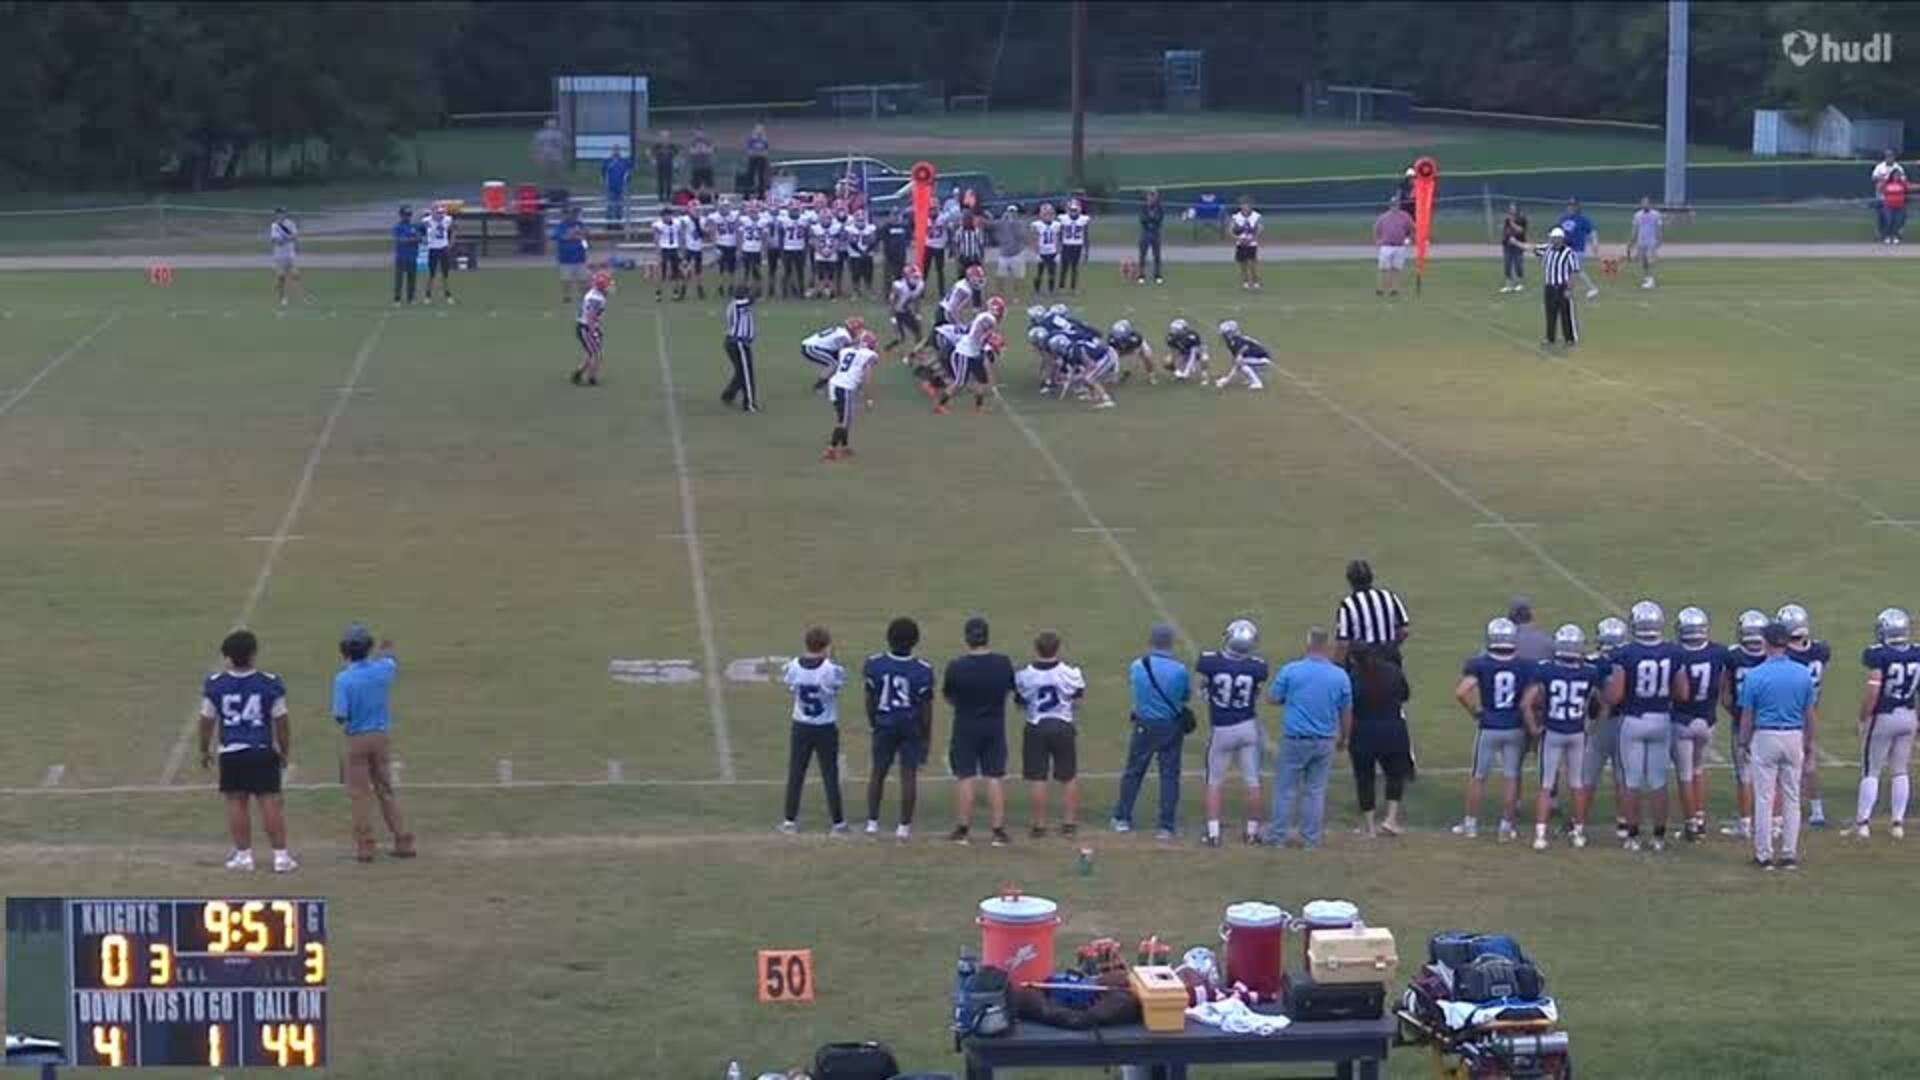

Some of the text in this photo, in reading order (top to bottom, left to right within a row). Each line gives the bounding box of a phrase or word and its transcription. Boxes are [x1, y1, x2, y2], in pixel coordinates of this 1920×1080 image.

[838, 351, 857, 373] 9
[878, 673, 911, 711] 13
[1212, 673, 1254, 709] 33
[1494, 671, 1515, 708] 8
[1635, 658, 1671, 697] 81
[1886, 661, 1920, 700] 27
[221, 693, 264, 727] 54
[800, 684, 825, 718] 5
[1036, 685, 1060, 713] 2
[1549, 680, 1590, 720] 25
[766, 956, 806, 998] 50
